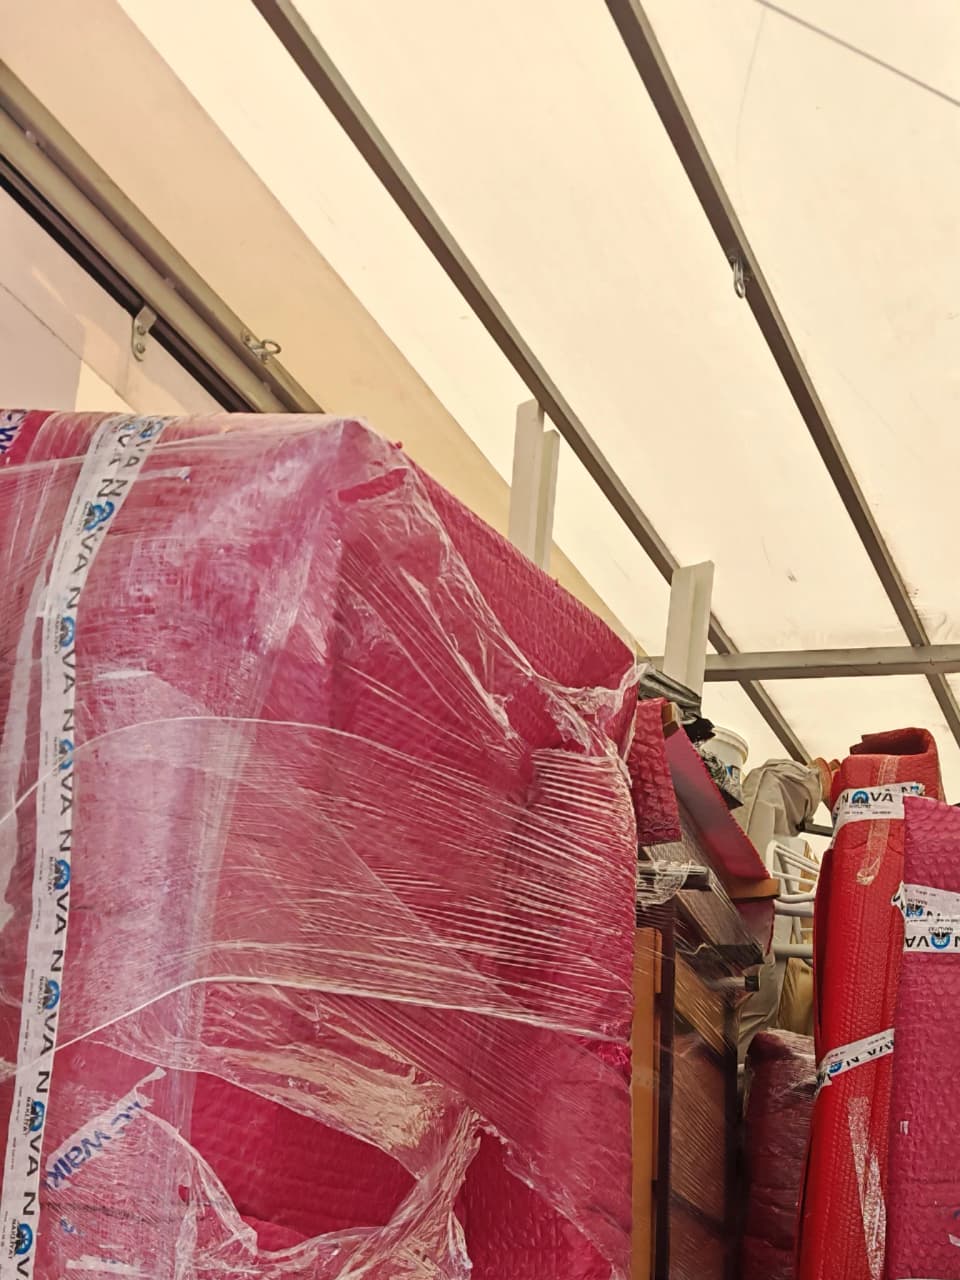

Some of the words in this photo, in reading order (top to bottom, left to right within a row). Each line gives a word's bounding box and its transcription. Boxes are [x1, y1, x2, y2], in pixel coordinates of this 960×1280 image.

[53, 829, 72, 936] NOVA
[40, 950, 64, 1056] NOVA
[27, 1070, 51, 1177] NOVA
